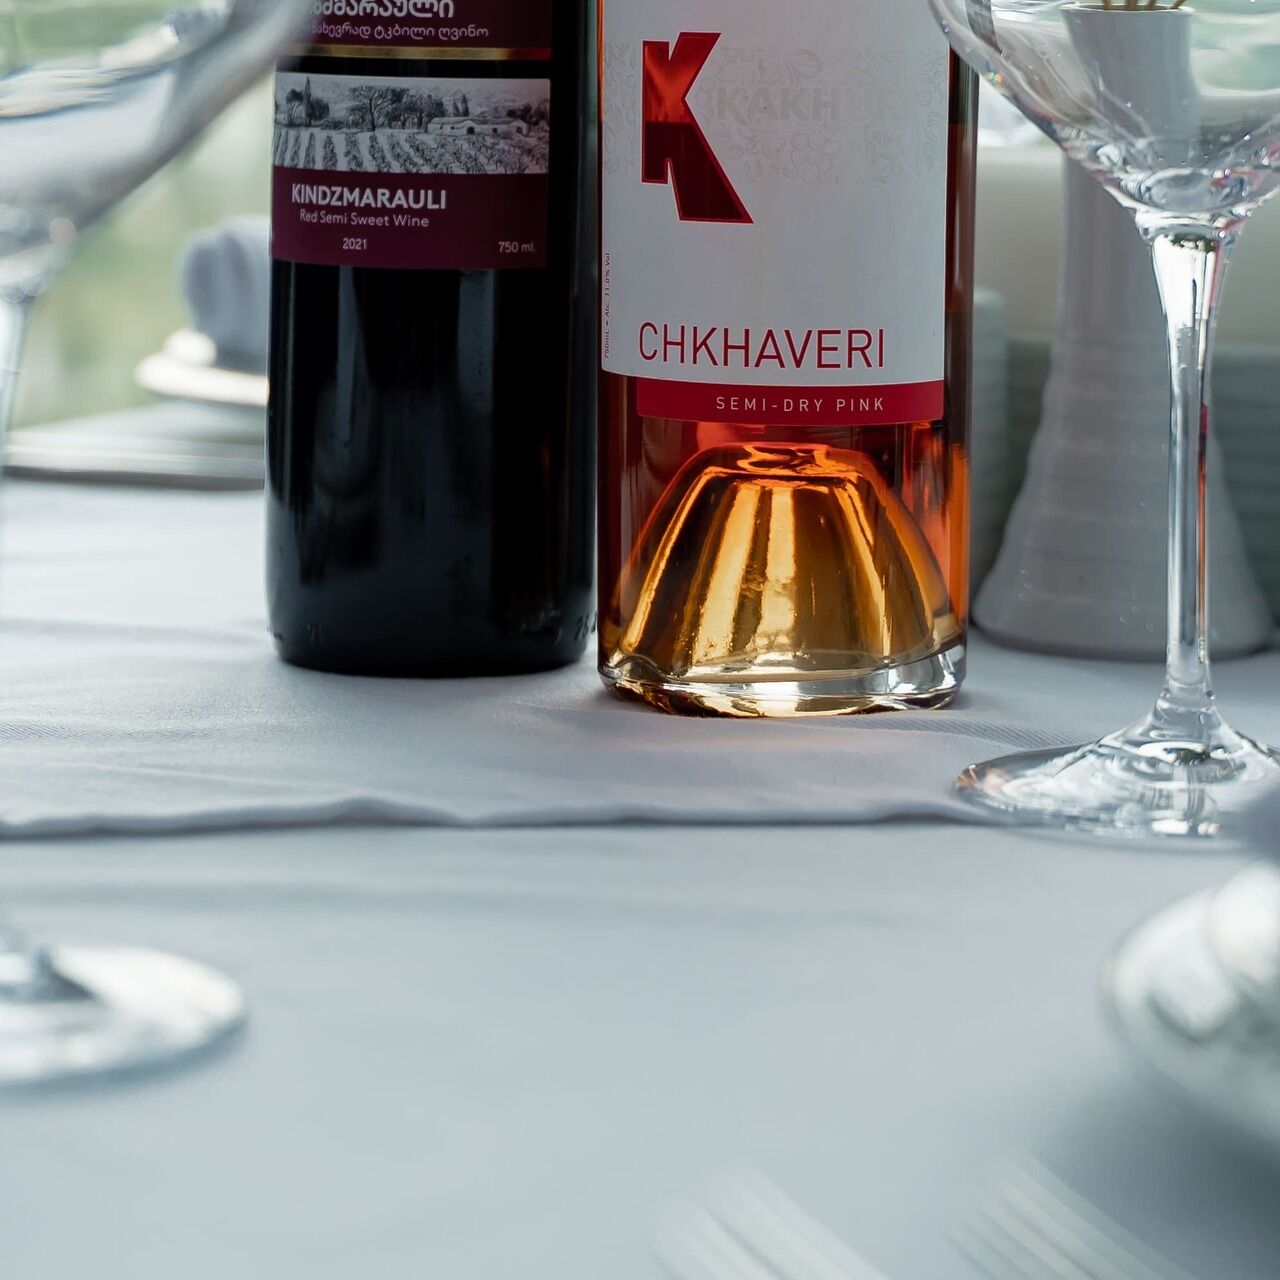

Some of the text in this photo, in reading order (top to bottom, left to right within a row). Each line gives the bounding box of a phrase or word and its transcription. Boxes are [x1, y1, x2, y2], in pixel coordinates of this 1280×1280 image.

[291, 183, 448, 210] KINDZMARAULI
[300, 209, 430, 228] Red Semi Sweet Wine
[342, 237, 368, 250] 2021
[498, 241, 519, 254] 750
[638, 321, 885, 370] CHKHAVERI
[716, 397, 884, 412] SEMI-DRY PINK
